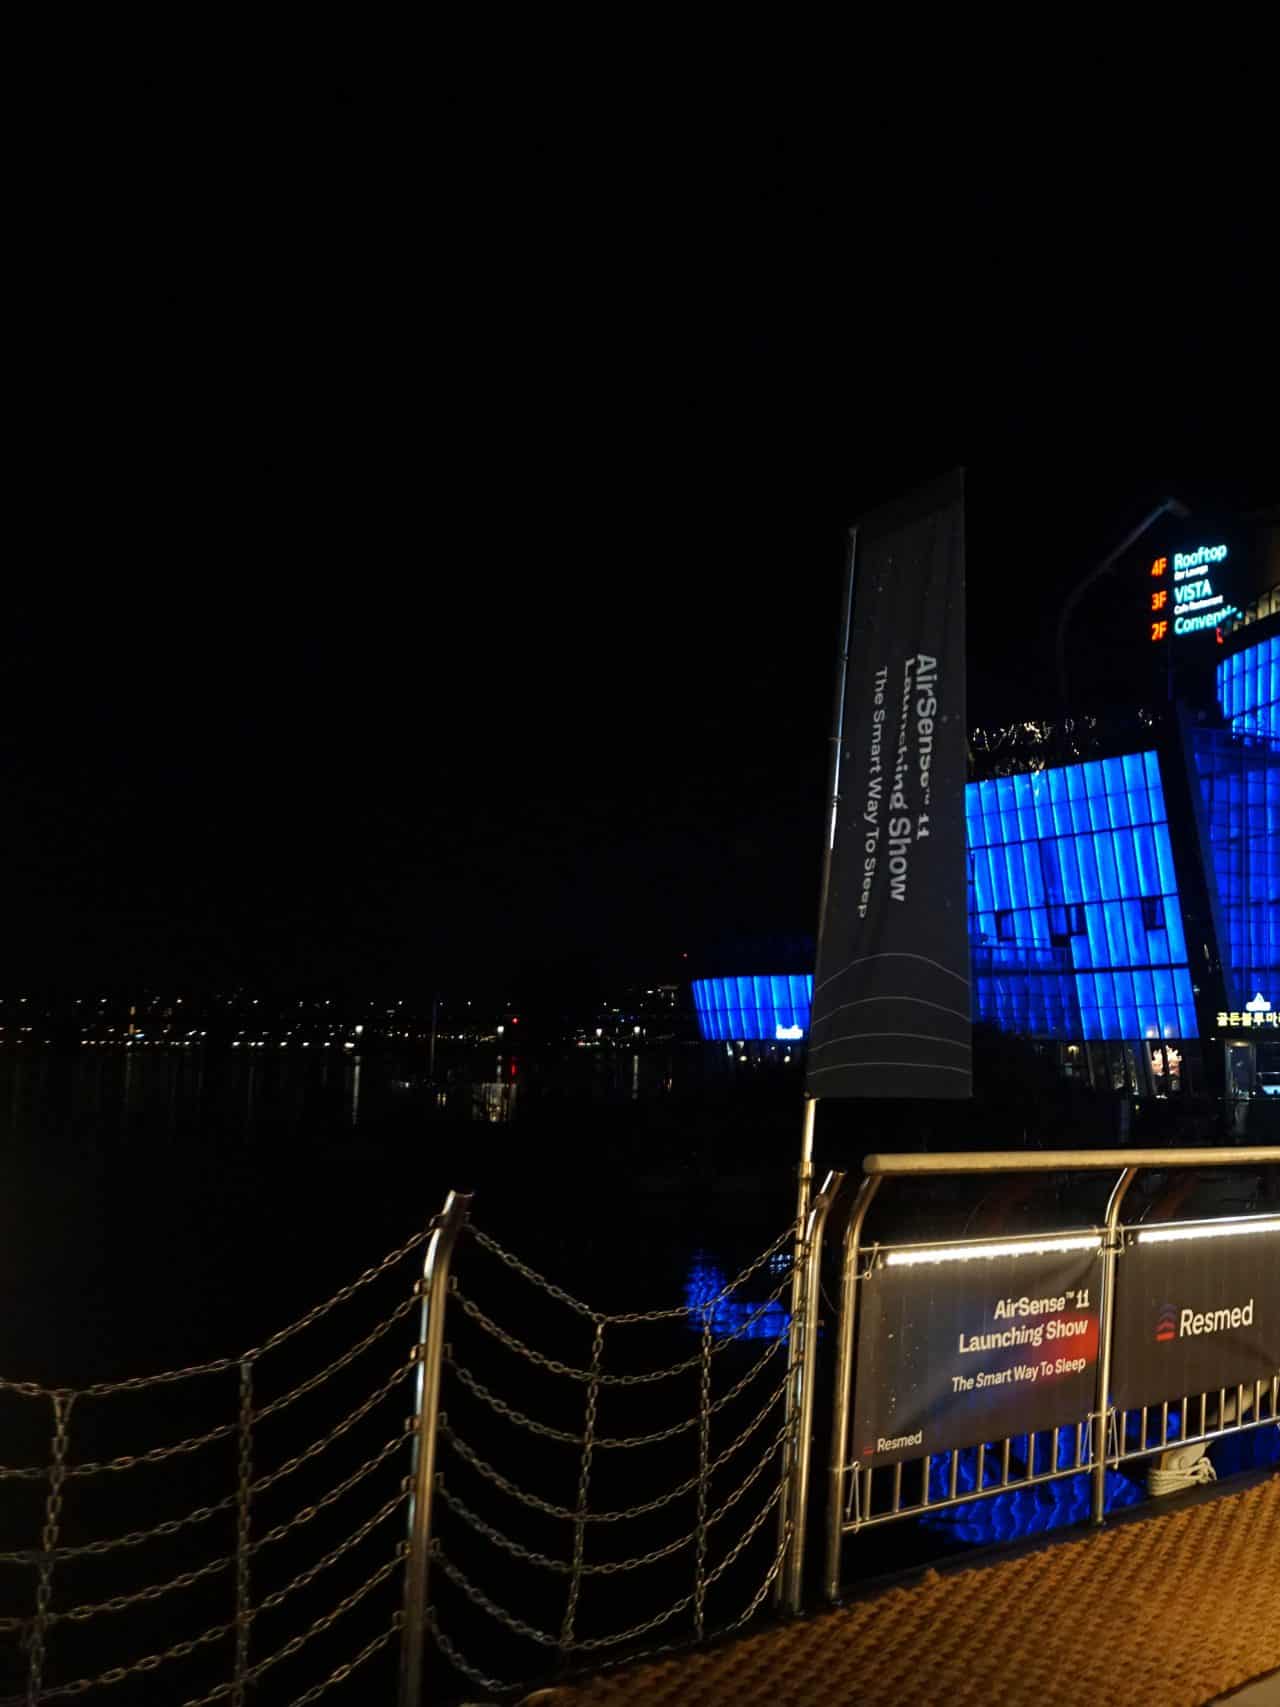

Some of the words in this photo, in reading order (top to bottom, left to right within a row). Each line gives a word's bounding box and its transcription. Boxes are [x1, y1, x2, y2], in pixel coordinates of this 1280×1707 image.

[1151, 557, 1168, 577] 4F
[1174, 544, 1228, 571] Rooftop
[1151, 590, 1168, 611] 3F
[1174, 578, 1213, 604] VISTA
[1151, 621, 1168, 641] 2F
[874, 666, 888, 706] The
[869, 708, 886, 774] Smart
[889, 658, 916, 811] Launching
[863, 776, 884, 825] Way
[865, 826, 880, 853] To
[916, 812, 930, 841] 11
[888, 816, 912, 902] Show
[857, 857, 877, 919] Sleep
[1075, 1288, 1091, 1310] 11
[1179, 1298, 1255, 1338] Resmed
[958, 1323, 1045, 1354] Launching
[1045, 1319, 1089, 1341] Show
[951, 1374, 975, 1393] The
[975, 1368, 1013, 1389] Smart
[1012, 1364, 1040, 1383] Way
[1040, 1360, 1054, 1377] To
[1054, 1357, 1087, 1375] Sleep
[876, 1429, 924, 1454] Resmed
